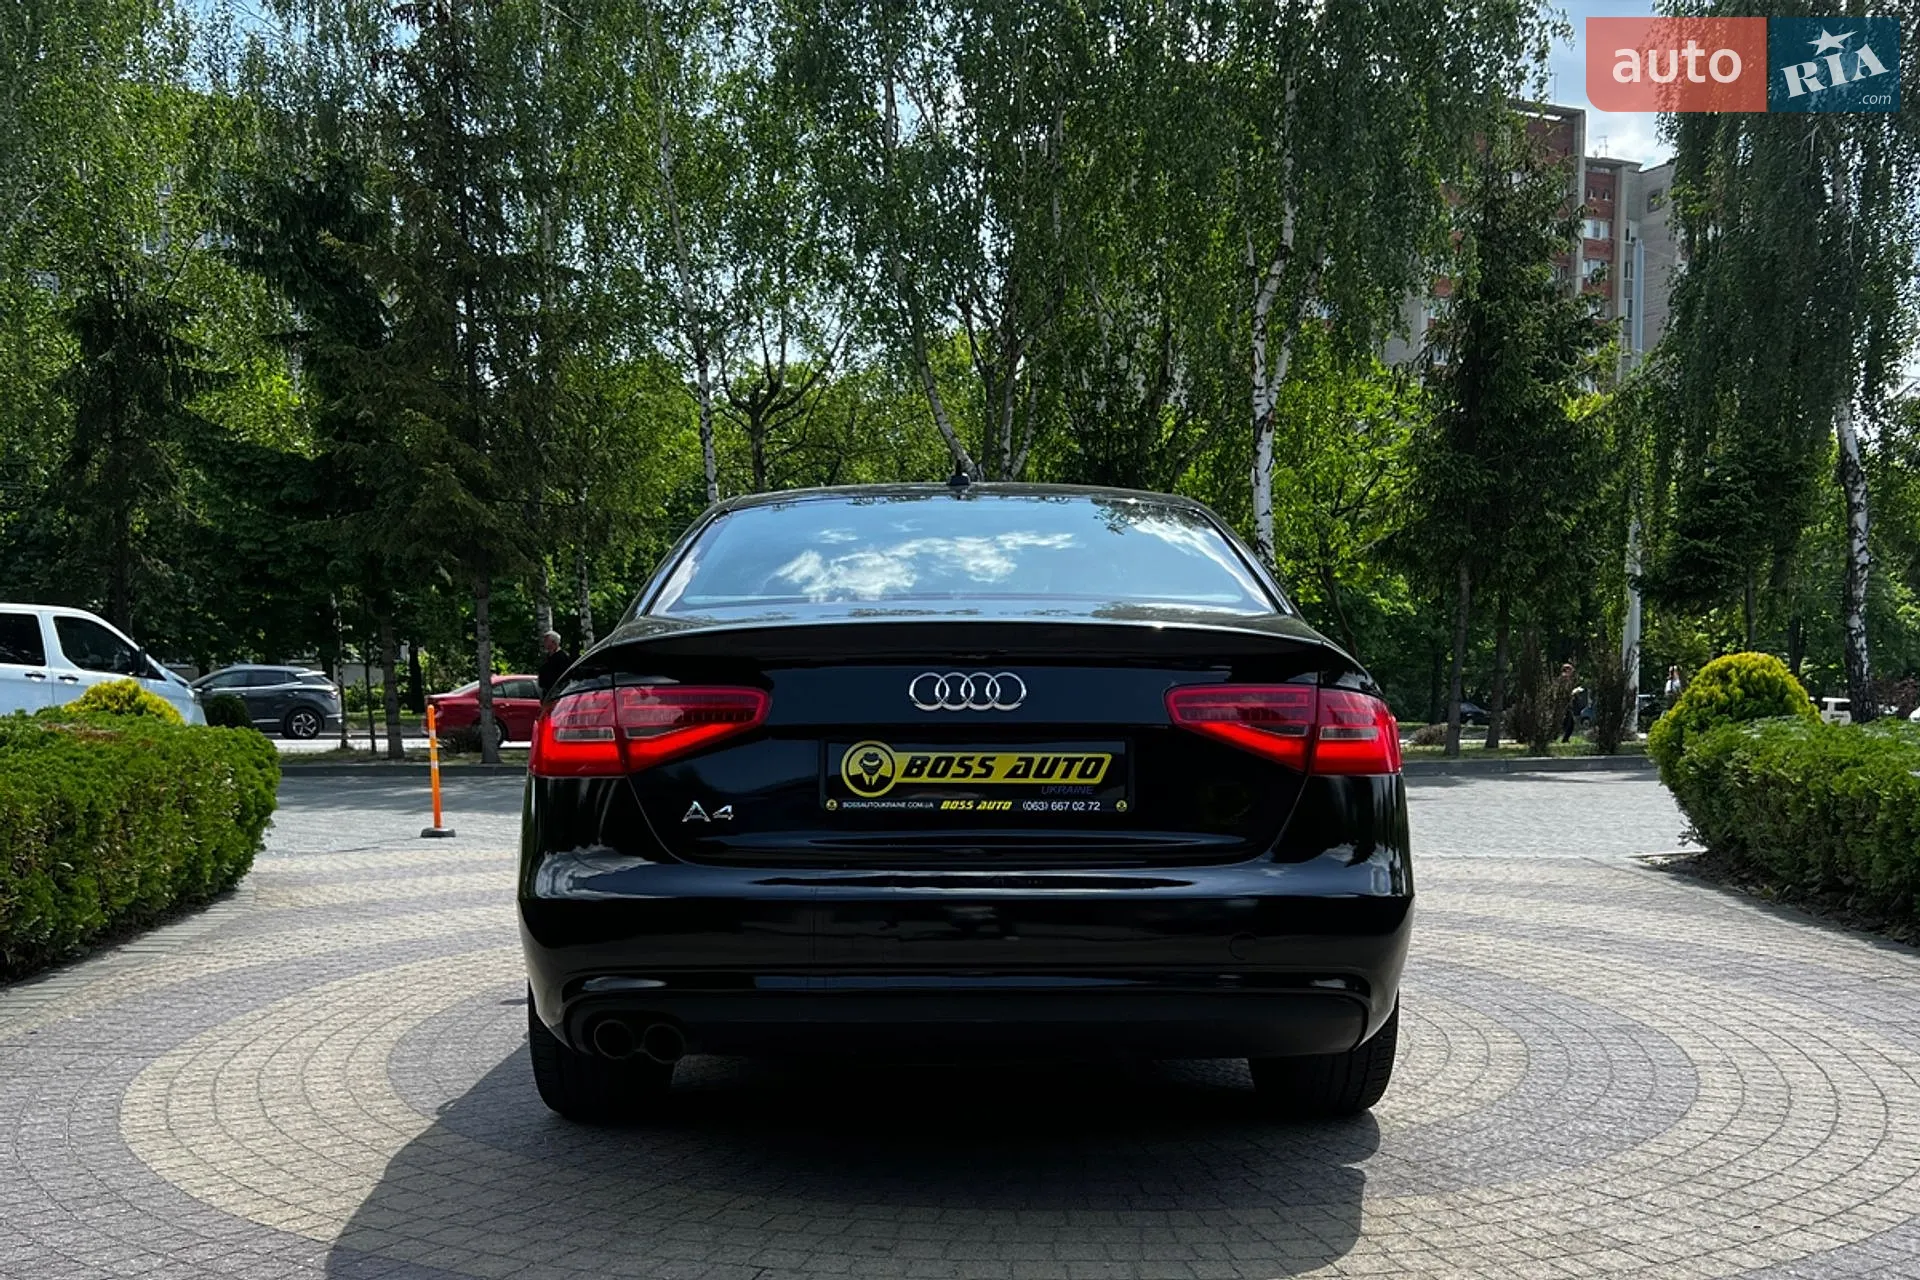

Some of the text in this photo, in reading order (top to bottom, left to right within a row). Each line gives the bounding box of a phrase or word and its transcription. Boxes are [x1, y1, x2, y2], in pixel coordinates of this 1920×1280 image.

[901, 756, 1106, 779] BOSS AUTO
[1041, 785, 1095, 795] UKRAINE
[940, 800, 1013, 810] BOSS AUTO
[1022, 801, 1101, 811] (063) 667 02 72
[682, 801, 734, 822] A4
